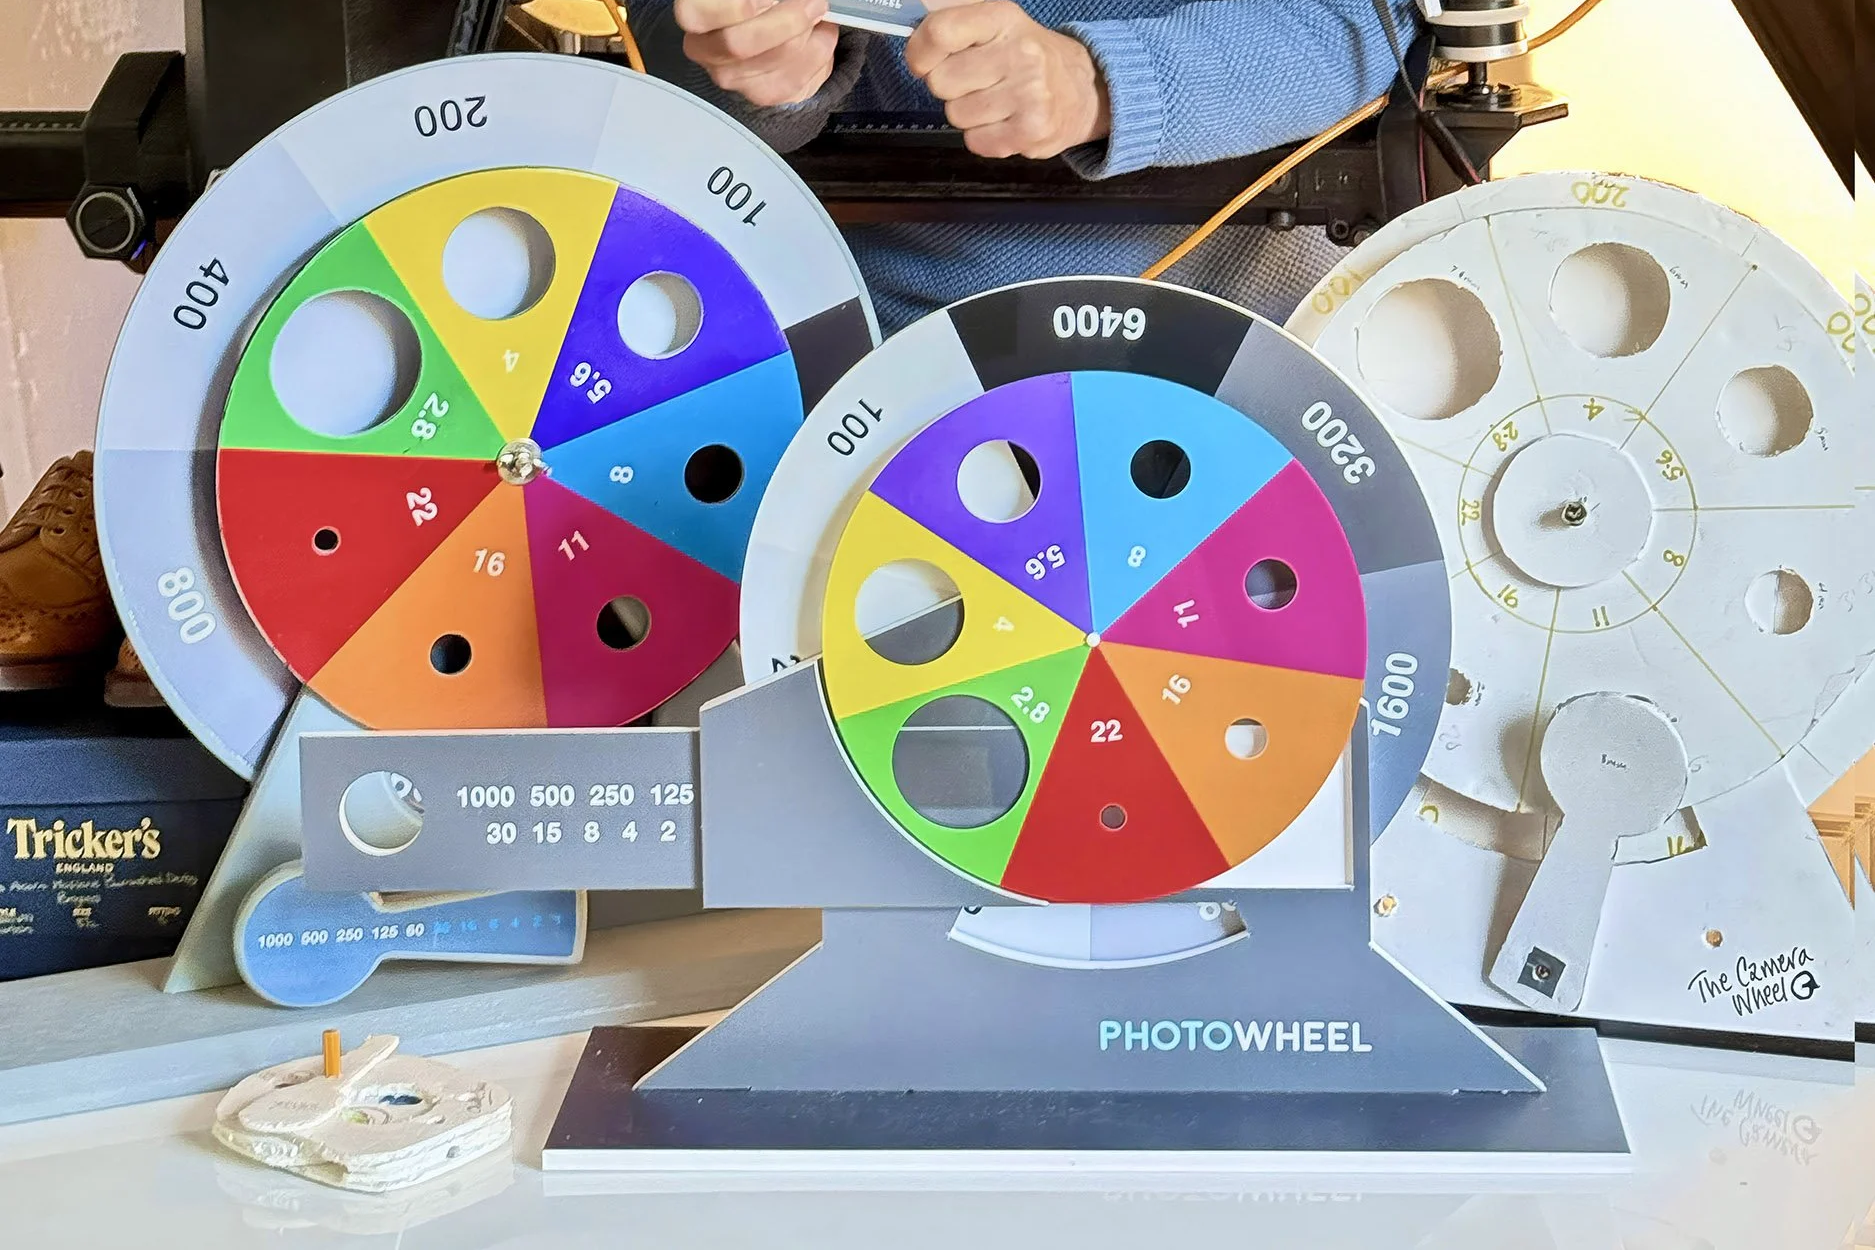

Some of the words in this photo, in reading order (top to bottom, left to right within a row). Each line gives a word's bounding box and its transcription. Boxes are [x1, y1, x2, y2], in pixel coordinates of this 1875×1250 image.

[414, 95, 487, 137] 200
[707, 166, 767, 227] 100
[1571, 181, 1630, 208] 200
[173, 257, 230, 331] 400
[1052, 304, 1146, 341] 6400
[502, 350, 520, 373] 4
[569, 362, 612, 404] 5.6
[410, 392, 449, 440] 2.8
[1583, 397, 1605, 421] 4
[827, 398, 884, 456] 100
[1301, 401, 1376, 484] 3200
[609, 466, 634, 484] 8
[406, 487, 438, 526] 22
[1461, 498, 1481, 527] 22
[557, 530, 590, 561] 11
[1127, 545, 1147, 568] 8
[1662, 549, 1685, 567] 8
[473, 548, 506, 577] 16
[1024, 545, 1066, 580] 5.6
[158, 567, 216, 644] 800
[1173, 599, 1199, 628] 11
[992, 616, 1014, 632] 4
[1010, 686, 1050, 724] 2.8
[1162, 673, 1192, 705] 16
[1371, 652, 1419, 738] 1600
[1090, 719, 1123, 743] 22
[456, 785, 516, 808] 1000
[530, 784, 576, 808] 500
[589, 784, 635, 806] 250
[650, 783, 694, 806] 125
[7, 817, 160, 859] Tricker's
[486, 822, 517, 845] 30
[532, 821, 562, 844] 15
[583, 821, 600, 843] 8
[622, 820, 638, 842] 4
[660, 820, 677, 842] 2
[55, 862, 114, 874] ENGLAND
[258, 934, 294, 949] 1000
[335, 927, 363, 943] 250
[371, 924, 399, 940] 125
[1688, 969, 1732, 1003] The
[1736, 946, 1814, 988] Camera
[1732, 976, 1788, 1016] Wheel
[1100, 1020, 1373, 1052] PHOTOWHEEL
